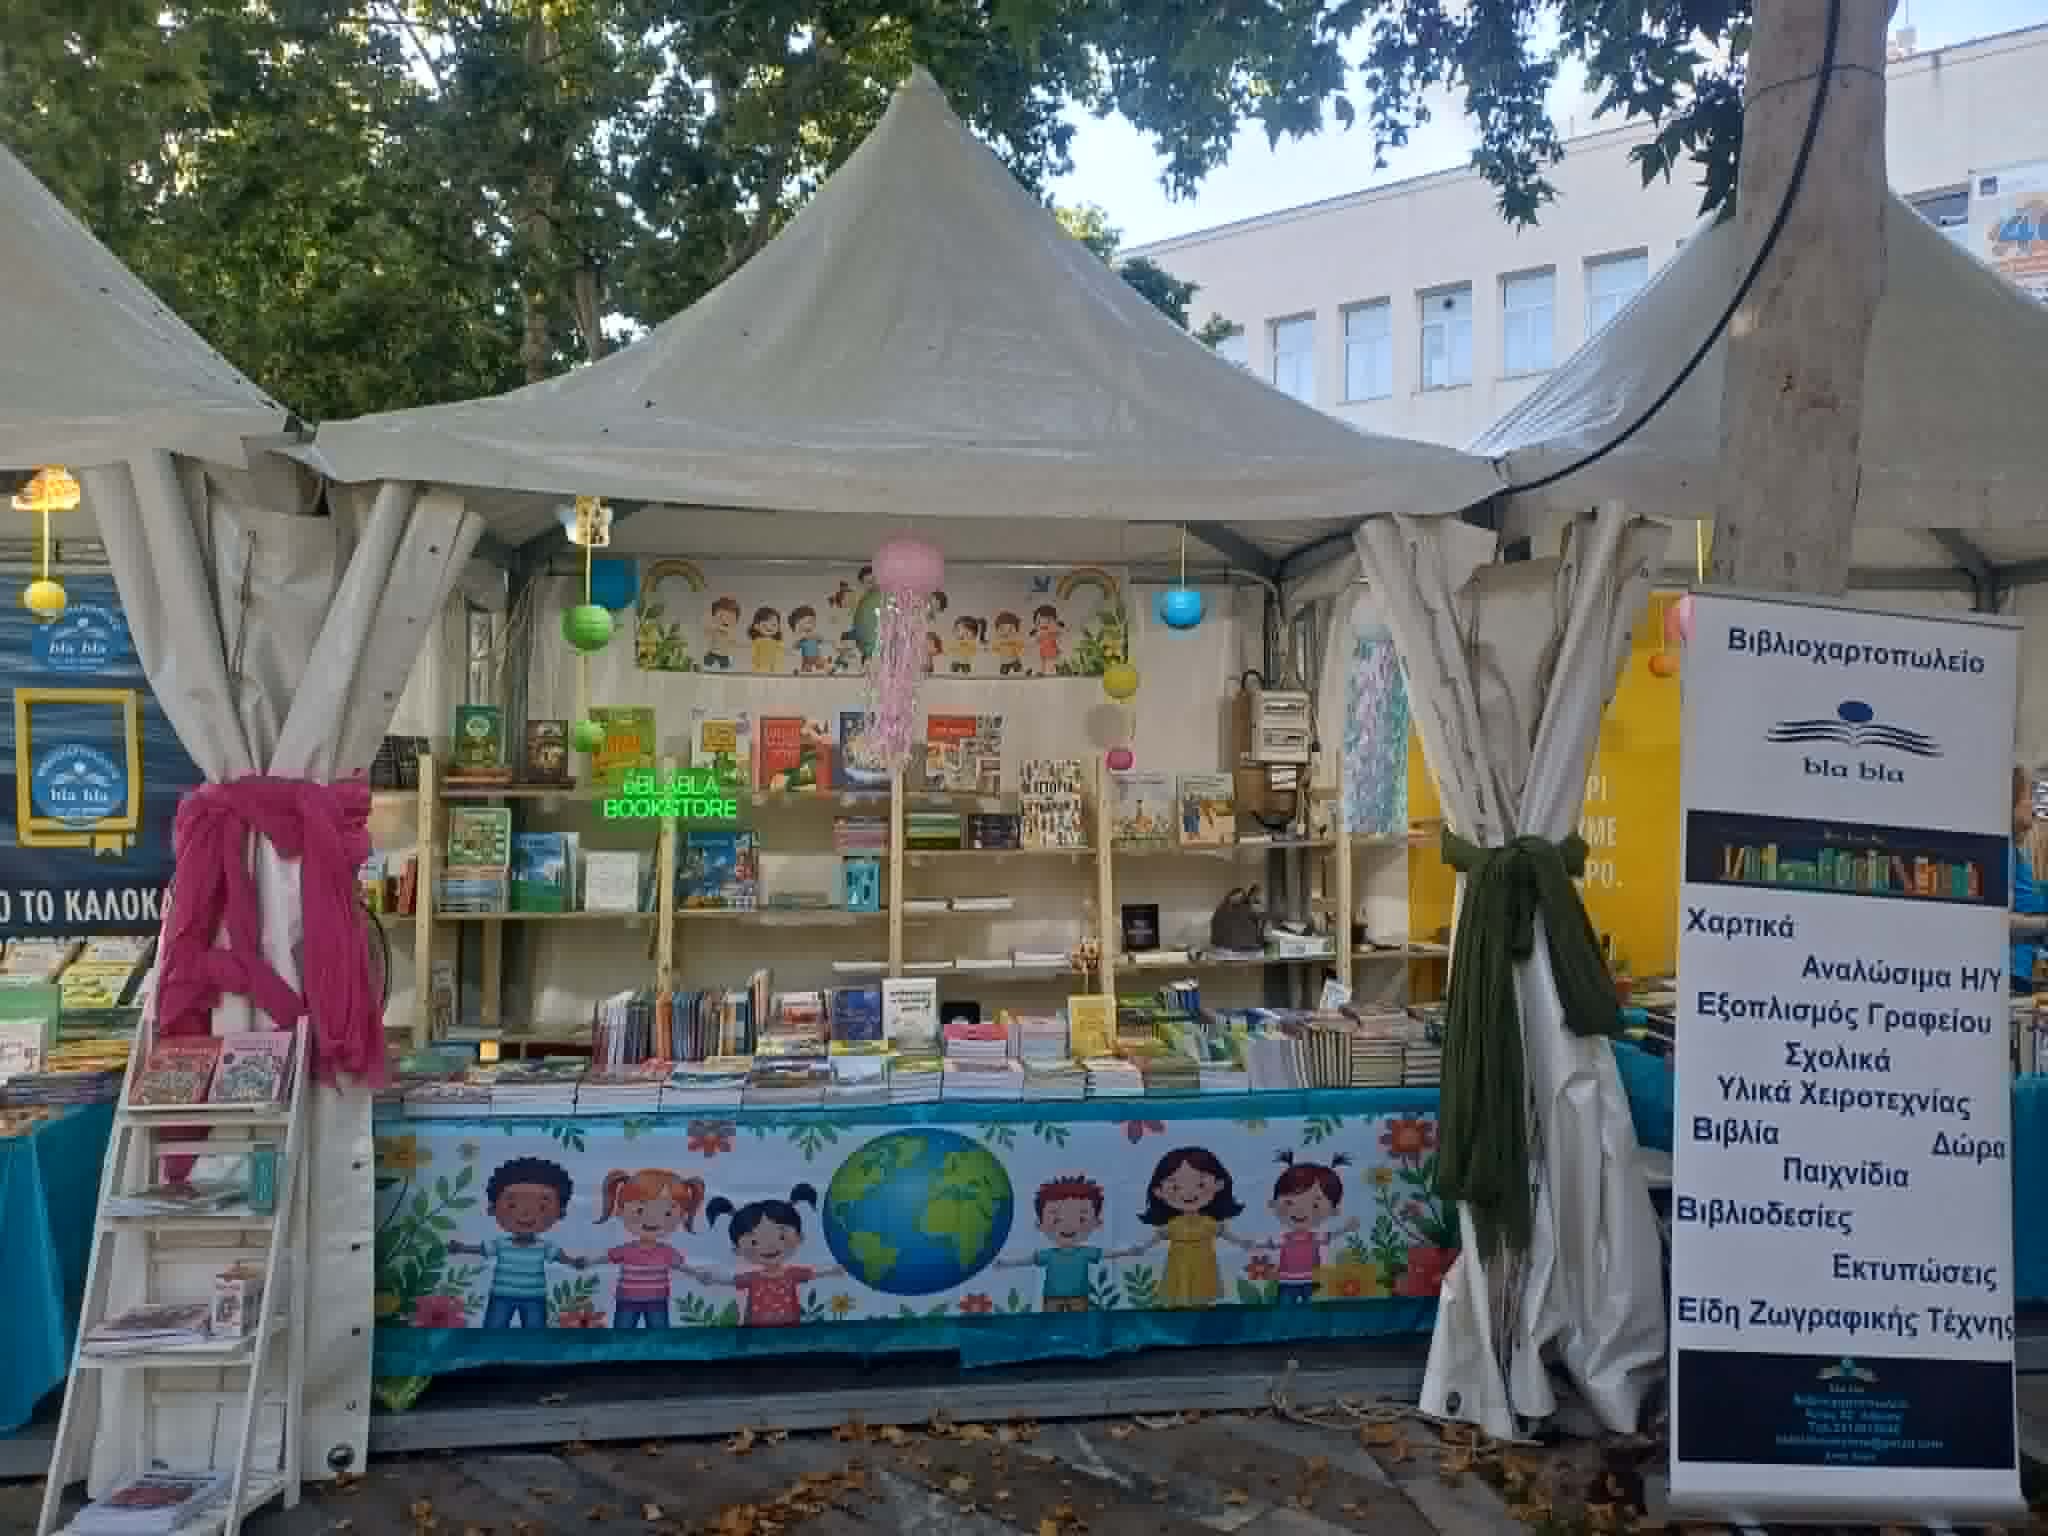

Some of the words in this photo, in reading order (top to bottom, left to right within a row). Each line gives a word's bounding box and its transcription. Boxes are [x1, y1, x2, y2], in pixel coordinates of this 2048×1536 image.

[1728, 627, 1985, 674] Βιβλιοχαρτοπωλείο
[1803, 757, 1848, 779] bla
[1859, 761, 1905, 783] bla
[603, 799, 738, 818] BOOKSTORE
[19, 889, 55, 923] ΤΟ
[64, 887, 176, 922] ΚΑΛΟΚΑ
[1687, 907, 1795, 940] Χαρτικά
[1802, 955, 1952, 992] Αναλώσιμα
[1697, 991, 1858, 1030] Εξοπλισμός
[1868, 1003, 1992, 1036] Γραφείου
[1785, 1042, 1891, 1073] Σχολικά
[1717, 1075, 1791, 1104] Υλικά
[1800, 1080, 1971, 1120] Χειροτεχνίας
[1693, 1116, 1780, 1148] Βιβλία
[1932, 1132, 2007, 1164] Δώρα
[1783, 1158, 1910, 1190] Παιχνίδια
[1677, 1197, 1853, 1234] Βιβλιοδεσίες
[1833, 1253, 1998, 1292] Εκτυπώσεις
[1678, 1297, 1740, 1329] Είδη
[1749, 1300, 1918, 1337] Ζωγραφικής
[1928, 1306, 2015, 1340] Τέχνης
